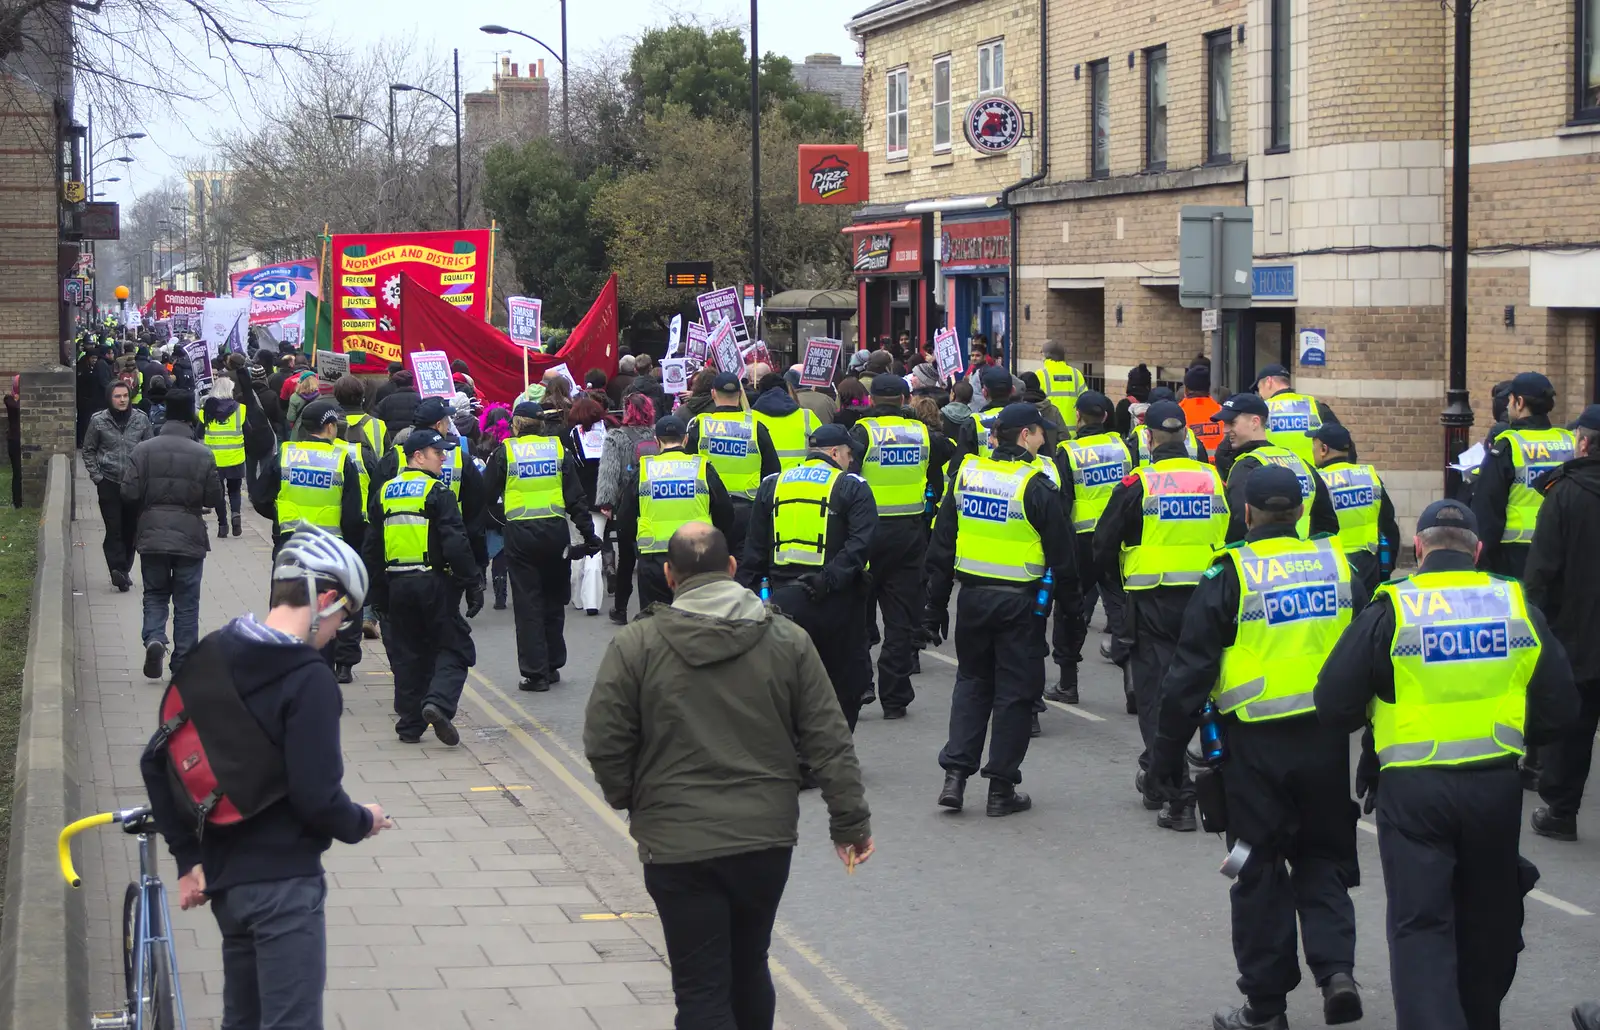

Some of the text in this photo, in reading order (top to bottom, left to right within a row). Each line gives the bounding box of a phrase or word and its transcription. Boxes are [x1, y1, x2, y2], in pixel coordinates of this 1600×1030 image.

[974, 102, 1017, 122] CHICKEN
[974, 129, 1017, 149] COTTAGE
[812, 169, 850, 190] Pizza
[819, 178, 845, 194] Hut
[345, 248, 471, 269] NORWICH AND DISTRICT
[868, 255, 888, 270] DELIVERY
[345, 276, 374, 284] FREEDOM
[443, 273, 474, 282] EQUALITY
[1259, 270, 1293, 293] HOUSE
[164, 294, 204, 305] CAMBRIDGE
[347, 298, 371, 307] JUSTICE
[512, 306, 534, 318] SMASH
[512, 315, 536, 328] THE EDL
[512, 325, 532, 336] & BNP
[346, 338, 384, 354] TRADES
[938, 336, 954, 350] SMASH
[808, 347, 832, 358] SMASH
[417, 361, 443, 371] SMASH
[807, 356, 832, 368] THE EDL
[419, 370, 449, 380] THE EDL
[804, 365, 826, 376] & BNP
[422, 380, 444, 390] & BNP
[706, 421, 727, 434] VA
[1272, 418, 1308, 430] POLICE
[872, 428, 896, 442] VA
[512, 444, 537, 457] VA
[710, 441, 747, 456] POLICE
[881, 448, 920, 463] POLICE
[1523, 443, 1550, 459] VA
[288, 450, 310, 464] VA
[1073, 448, 1100, 464] VA
[519, 462, 556, 476] POLICE
[649, 462, 673, 476] VA
[784, 468, 830, 482] POLICE
[1085, 466, 1123, 484] POLICE
[291, 472, 332, 486] POLICE
[962, 470, 984, 487] VA
[1321, 473, 1347, 486] VA
[386, 482, 425, 498] POLICE
[652, 482, 694, 497] POLICE
[1335, 491, 1372, 509] POLICE
[964, 498, 1008, 519] POLICE
[1160, 500, 1210, 516] POLICE
[1244, 559, 1289, 584] VA
[1267, 590, 1336, 620] POLICE
[1402, 592, 1452, 617] VA
[1424, 628, 1506, 657] POLICE
